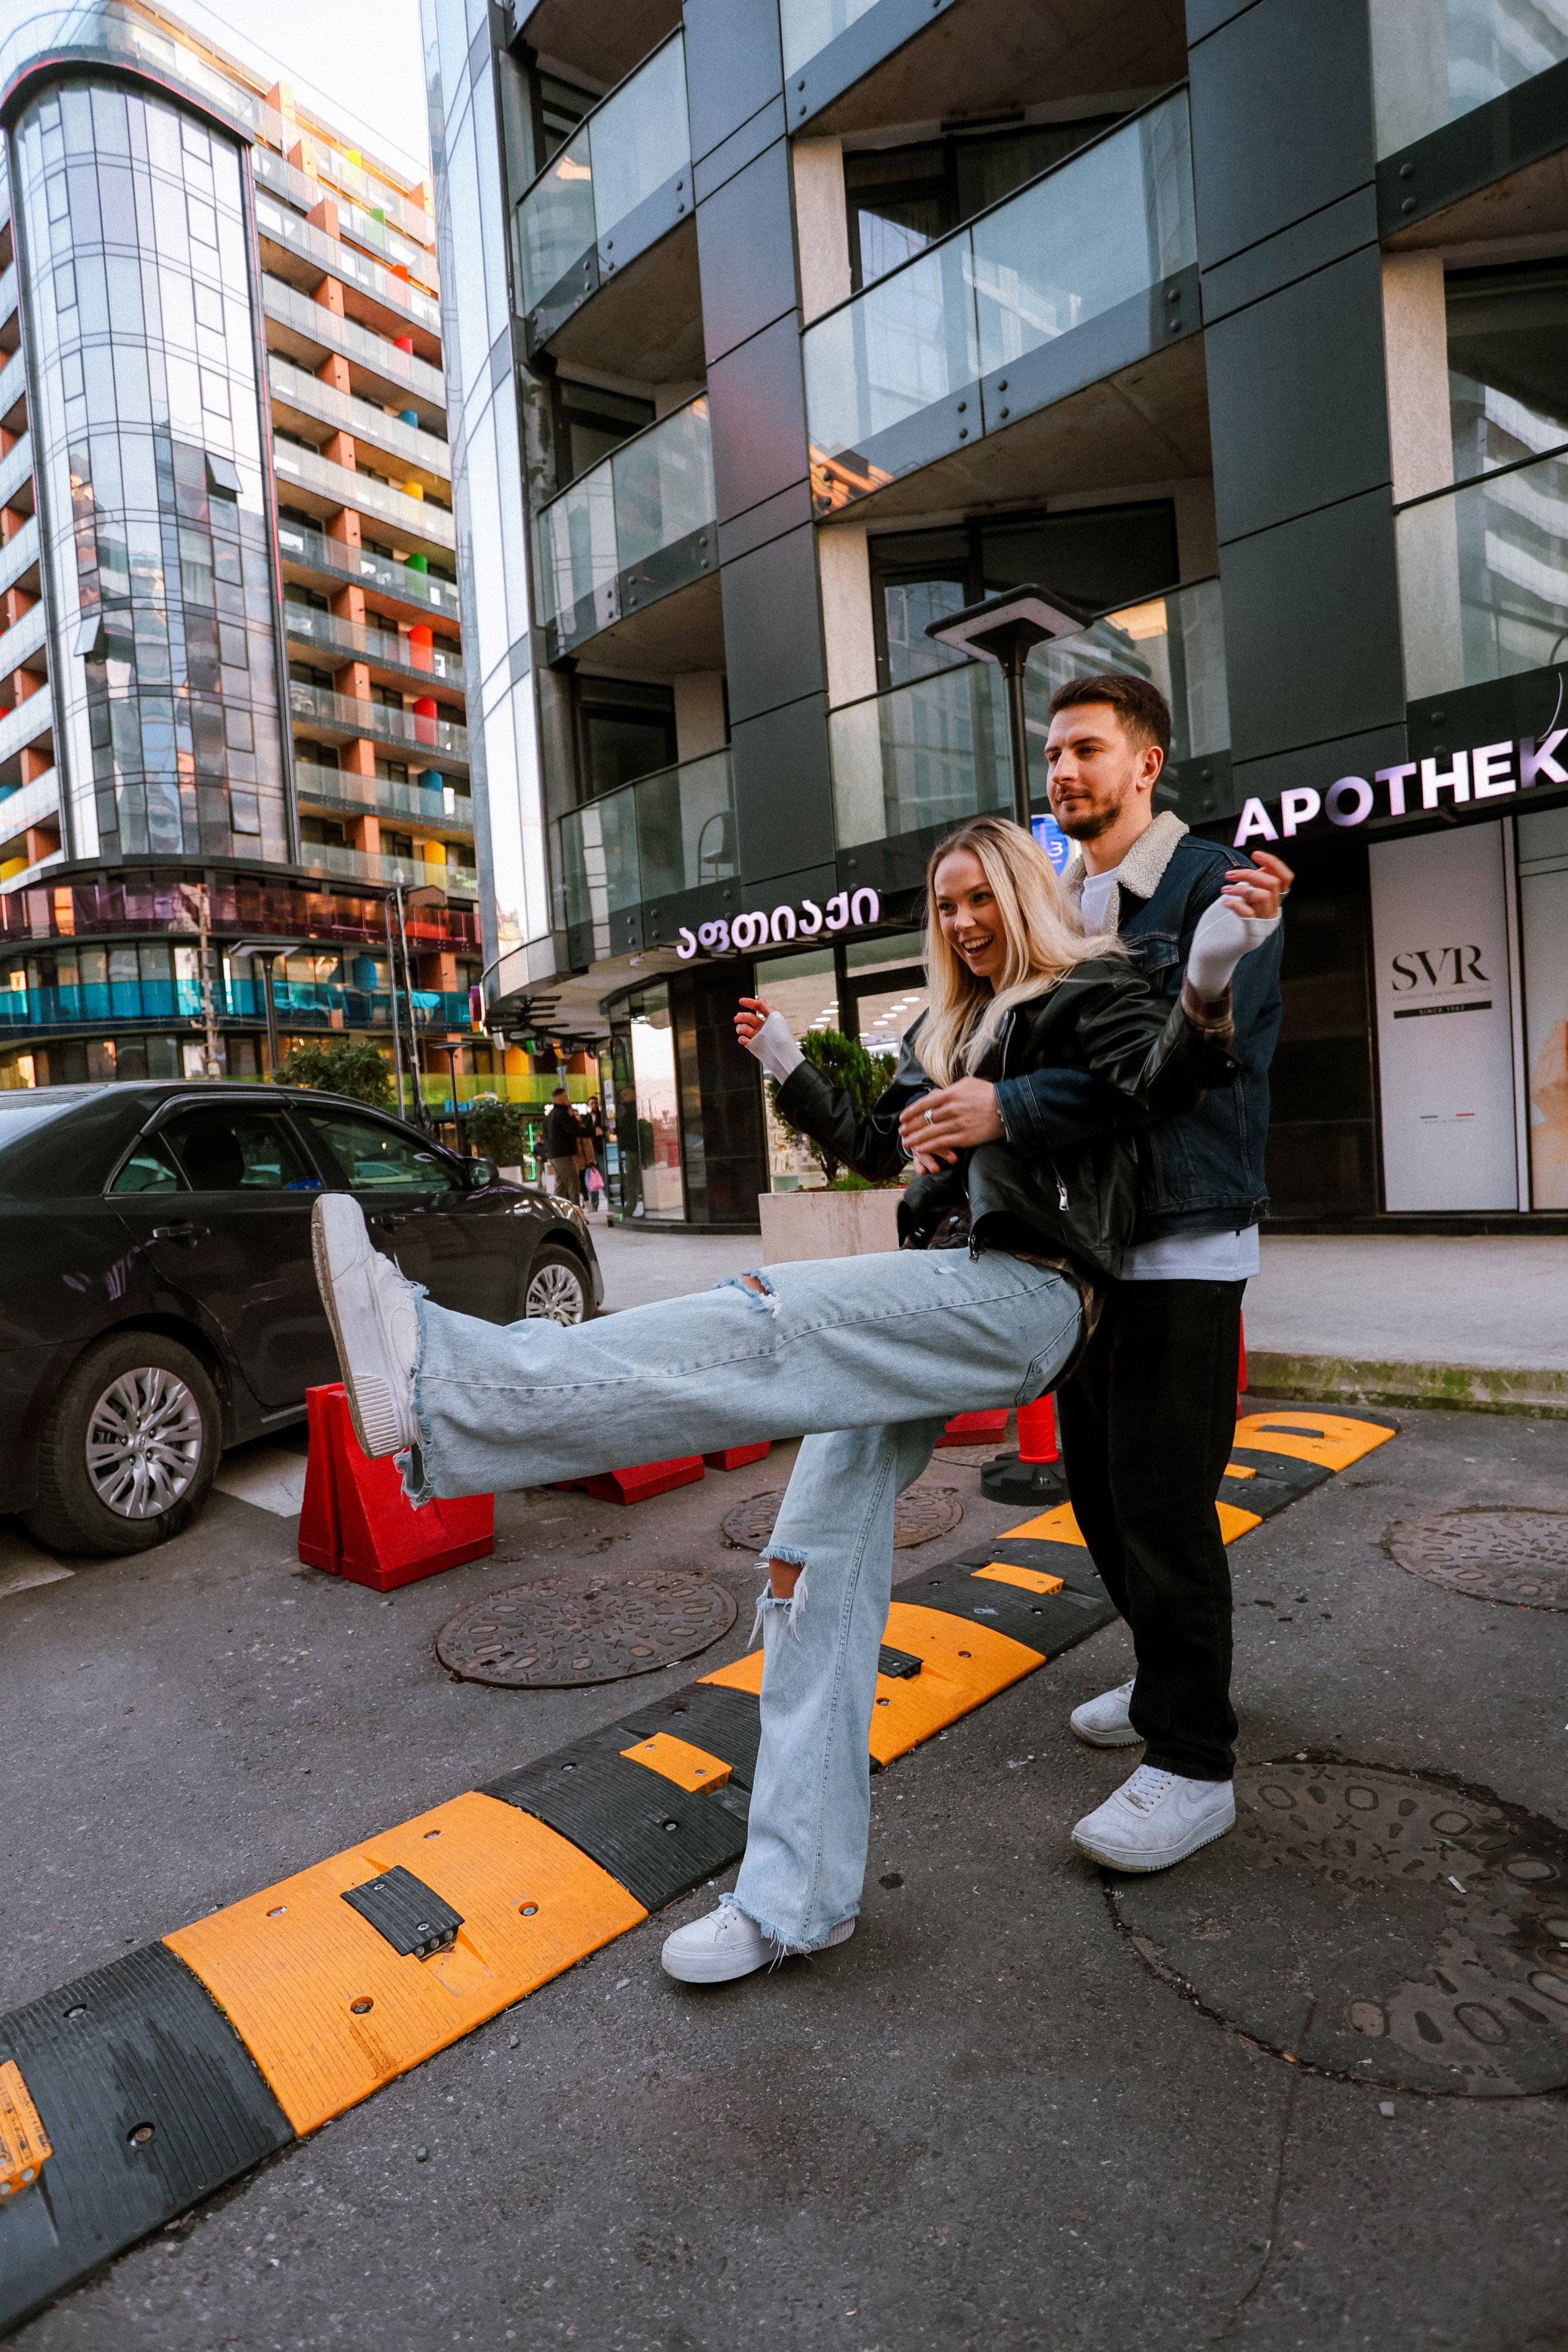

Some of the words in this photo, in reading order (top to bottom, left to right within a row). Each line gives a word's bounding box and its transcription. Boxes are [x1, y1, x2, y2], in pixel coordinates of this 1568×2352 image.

[1233, 728, 1568, 847] APOTHEK
[676, 888, 880, 959] აფთიაქი
[1392, 945, 1490, 991] SVR
